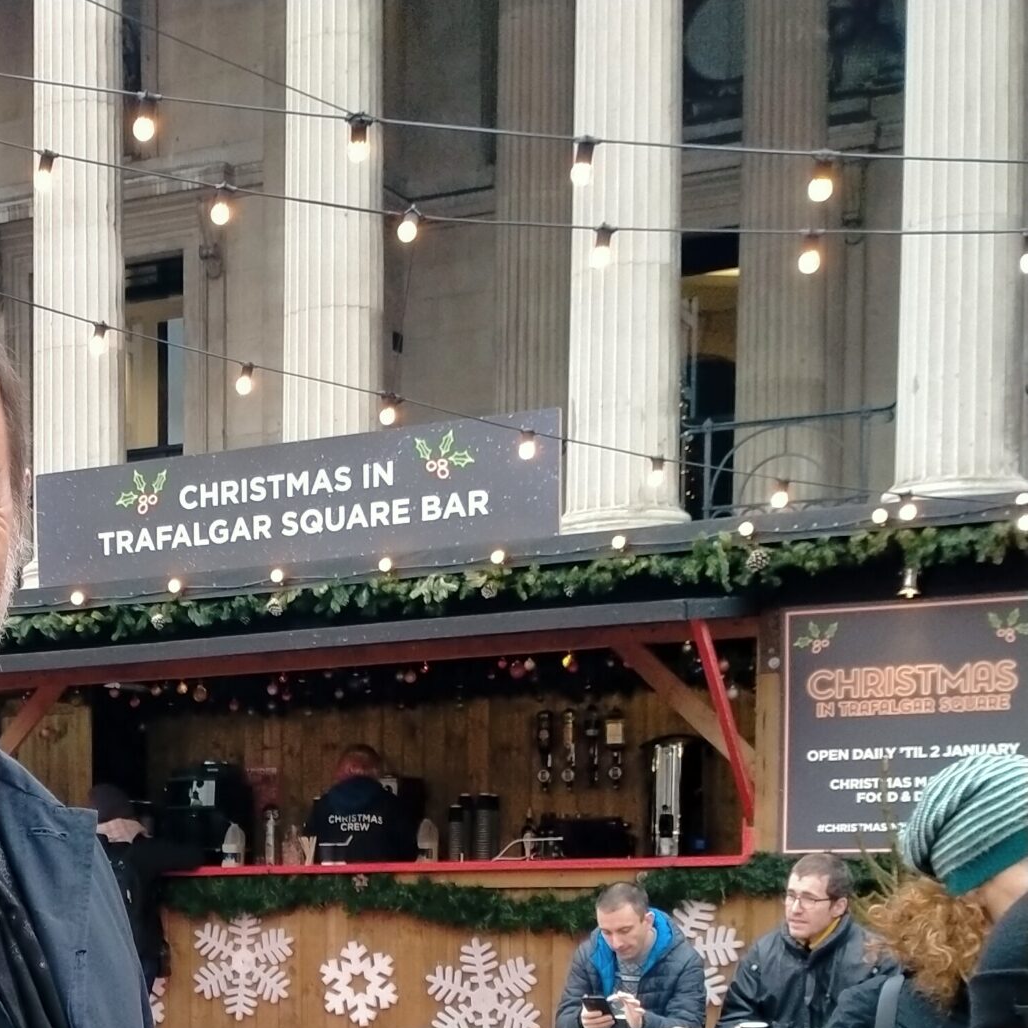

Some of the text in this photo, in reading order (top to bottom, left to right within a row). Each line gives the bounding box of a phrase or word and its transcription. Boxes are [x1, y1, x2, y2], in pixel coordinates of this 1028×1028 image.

[178, 461, 395, 511] CHRISTMAS IN
[98, 489, 489, 556] TRAFALGAR SQUARE BAR
[806, 660, 1018, 700] CHRISTMAS
[816, 694, 1010, 718] IN TRAFALGAR SQUARE
[806, 748, 850, 762] OPEN
[852, 747, 896, 760] DAILY
[930, 746, 940, 756] 2
[942, 742, 1020, 756] JANUARY
[900, 791, 912, 802] &
[328, 814, 383, 824] CHRISTMAS
[340, 823, 370, 831] CREW
